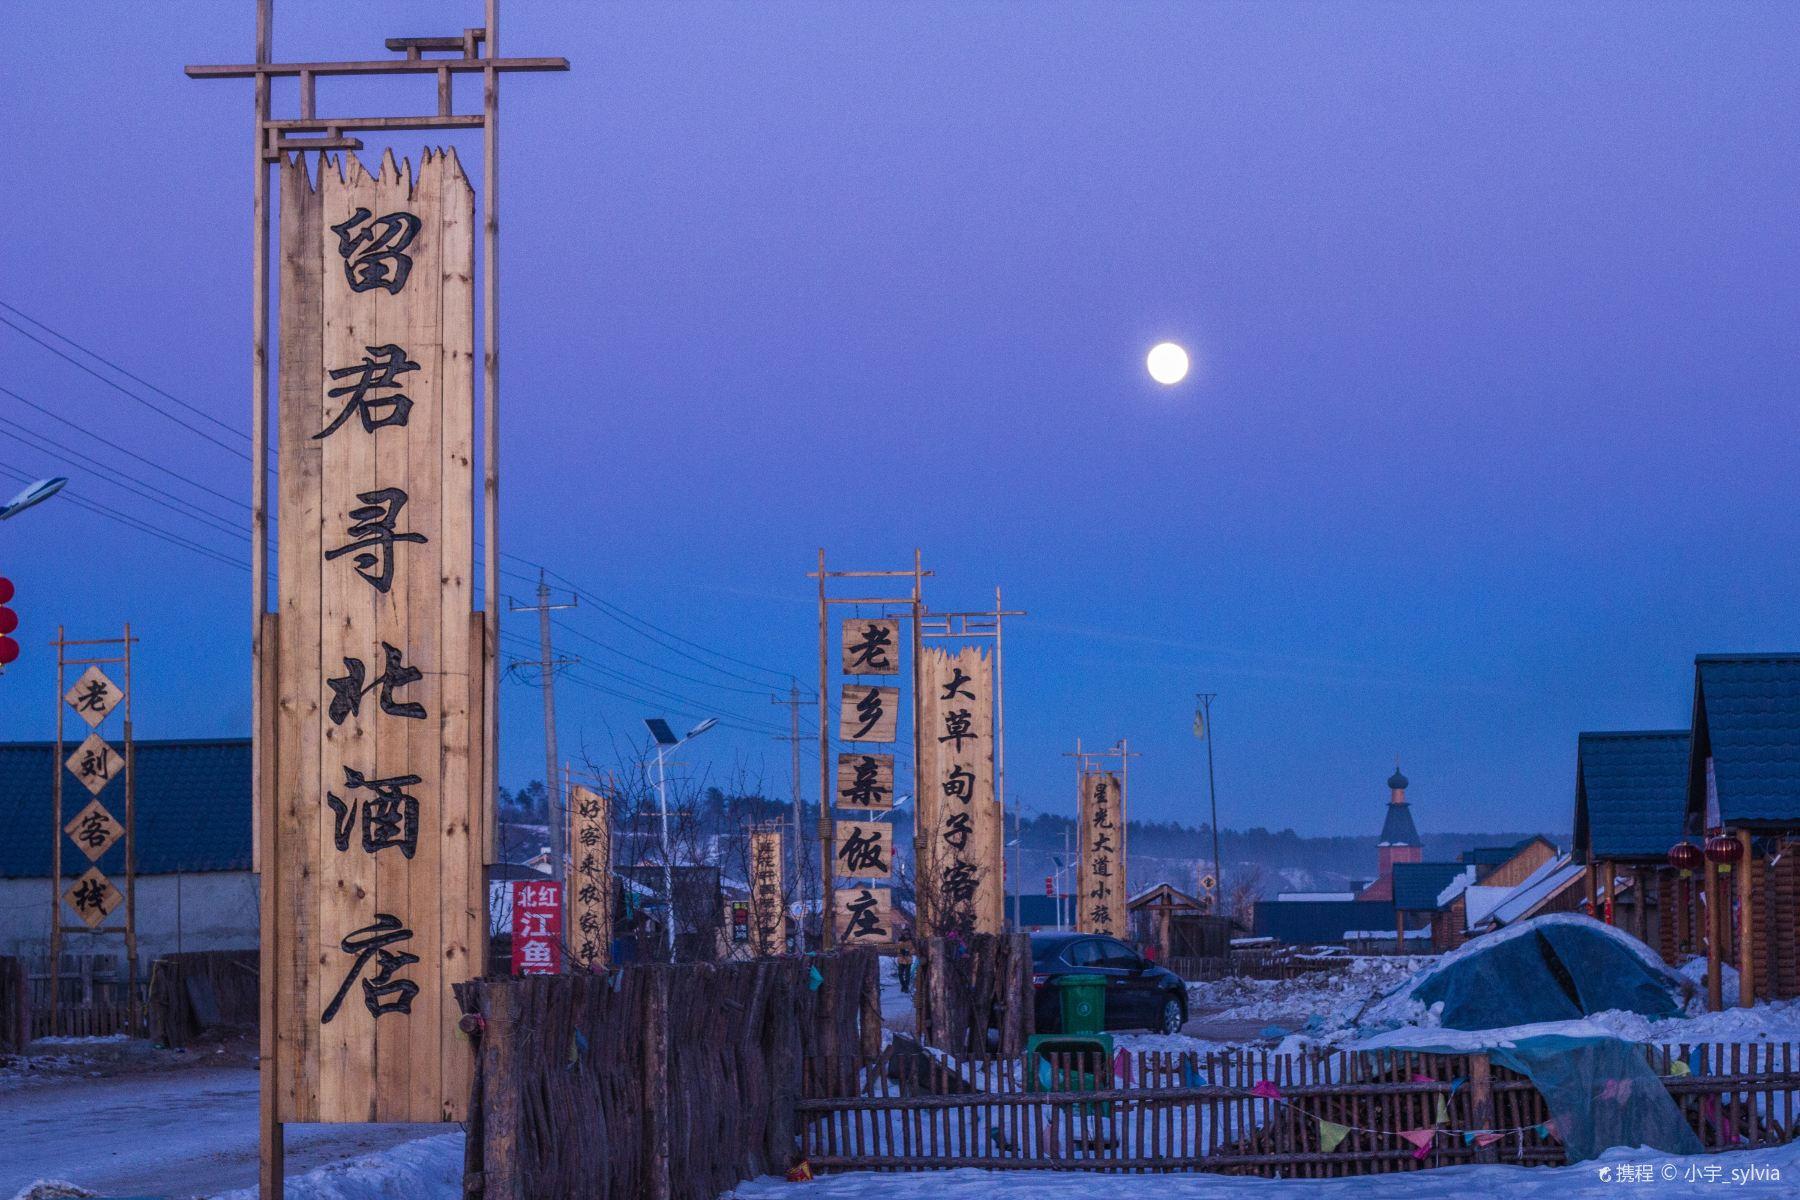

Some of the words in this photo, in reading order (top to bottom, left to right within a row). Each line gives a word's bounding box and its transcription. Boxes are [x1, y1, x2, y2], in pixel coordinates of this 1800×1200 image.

[73, 680, 111, 916] 老刘客栈
[839, 625, 893, 940] 老乡亲饭庄
[1090, 783, 1113, 935] 星光大道小旅
[517, 886, 558, 907] 北红
